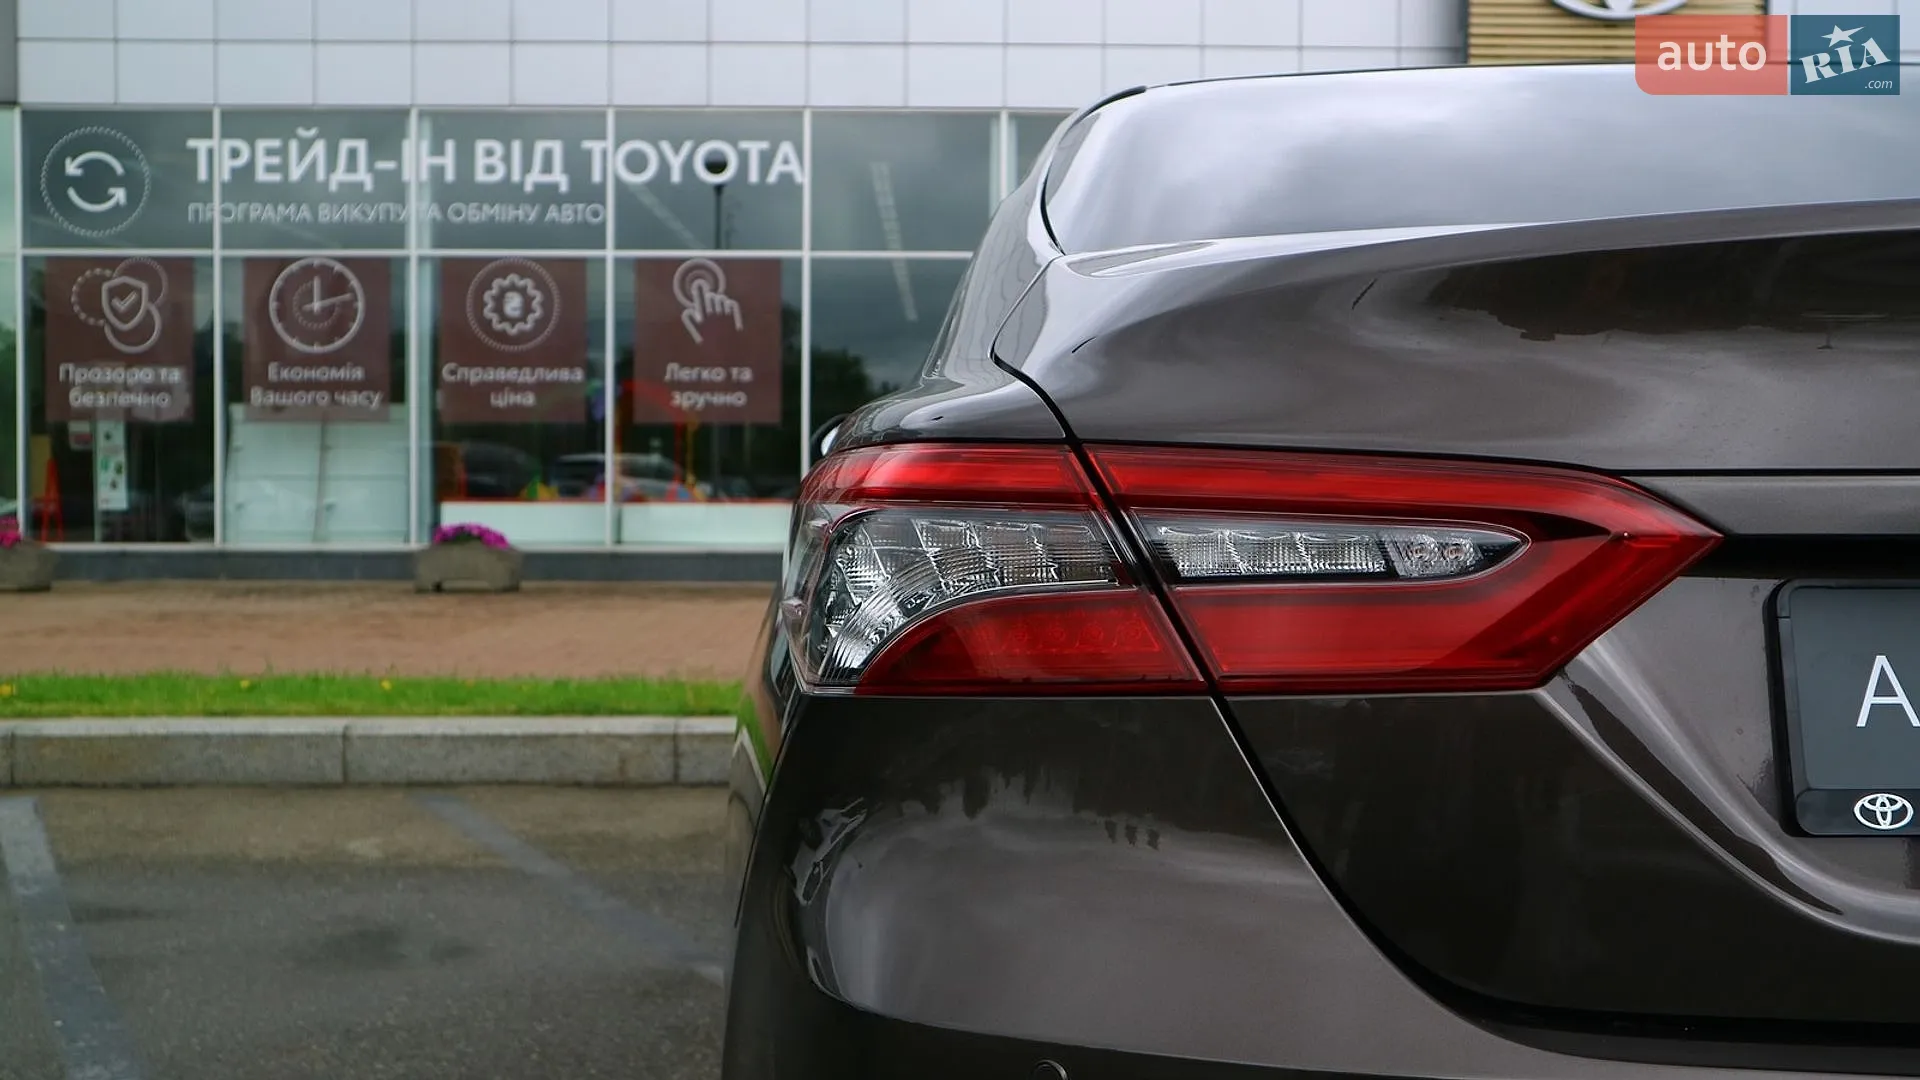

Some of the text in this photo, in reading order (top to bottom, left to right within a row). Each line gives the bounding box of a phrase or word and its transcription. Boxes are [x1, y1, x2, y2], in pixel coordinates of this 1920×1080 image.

[186, 127, 806, 193] ТРЕЙД-ІН ВІД TOYOTA
[187, 202, 312, 224] ПРОГРАМА
[318, 202, 408, 224] ВИКУПУ
[446, 202, 541, 224] ОБМІНУ
[544, 202, 606, 224] АВТО
[59, 362, 156, 387] Прозоро
[267, 361, 365, 382] Економія
[441, 362, 584, 387] Справедлива
[664, 362, 727, 383] Легко
[250, 385, 384, 412] Вашого часу
[489, 386, 537, 409] ціна
